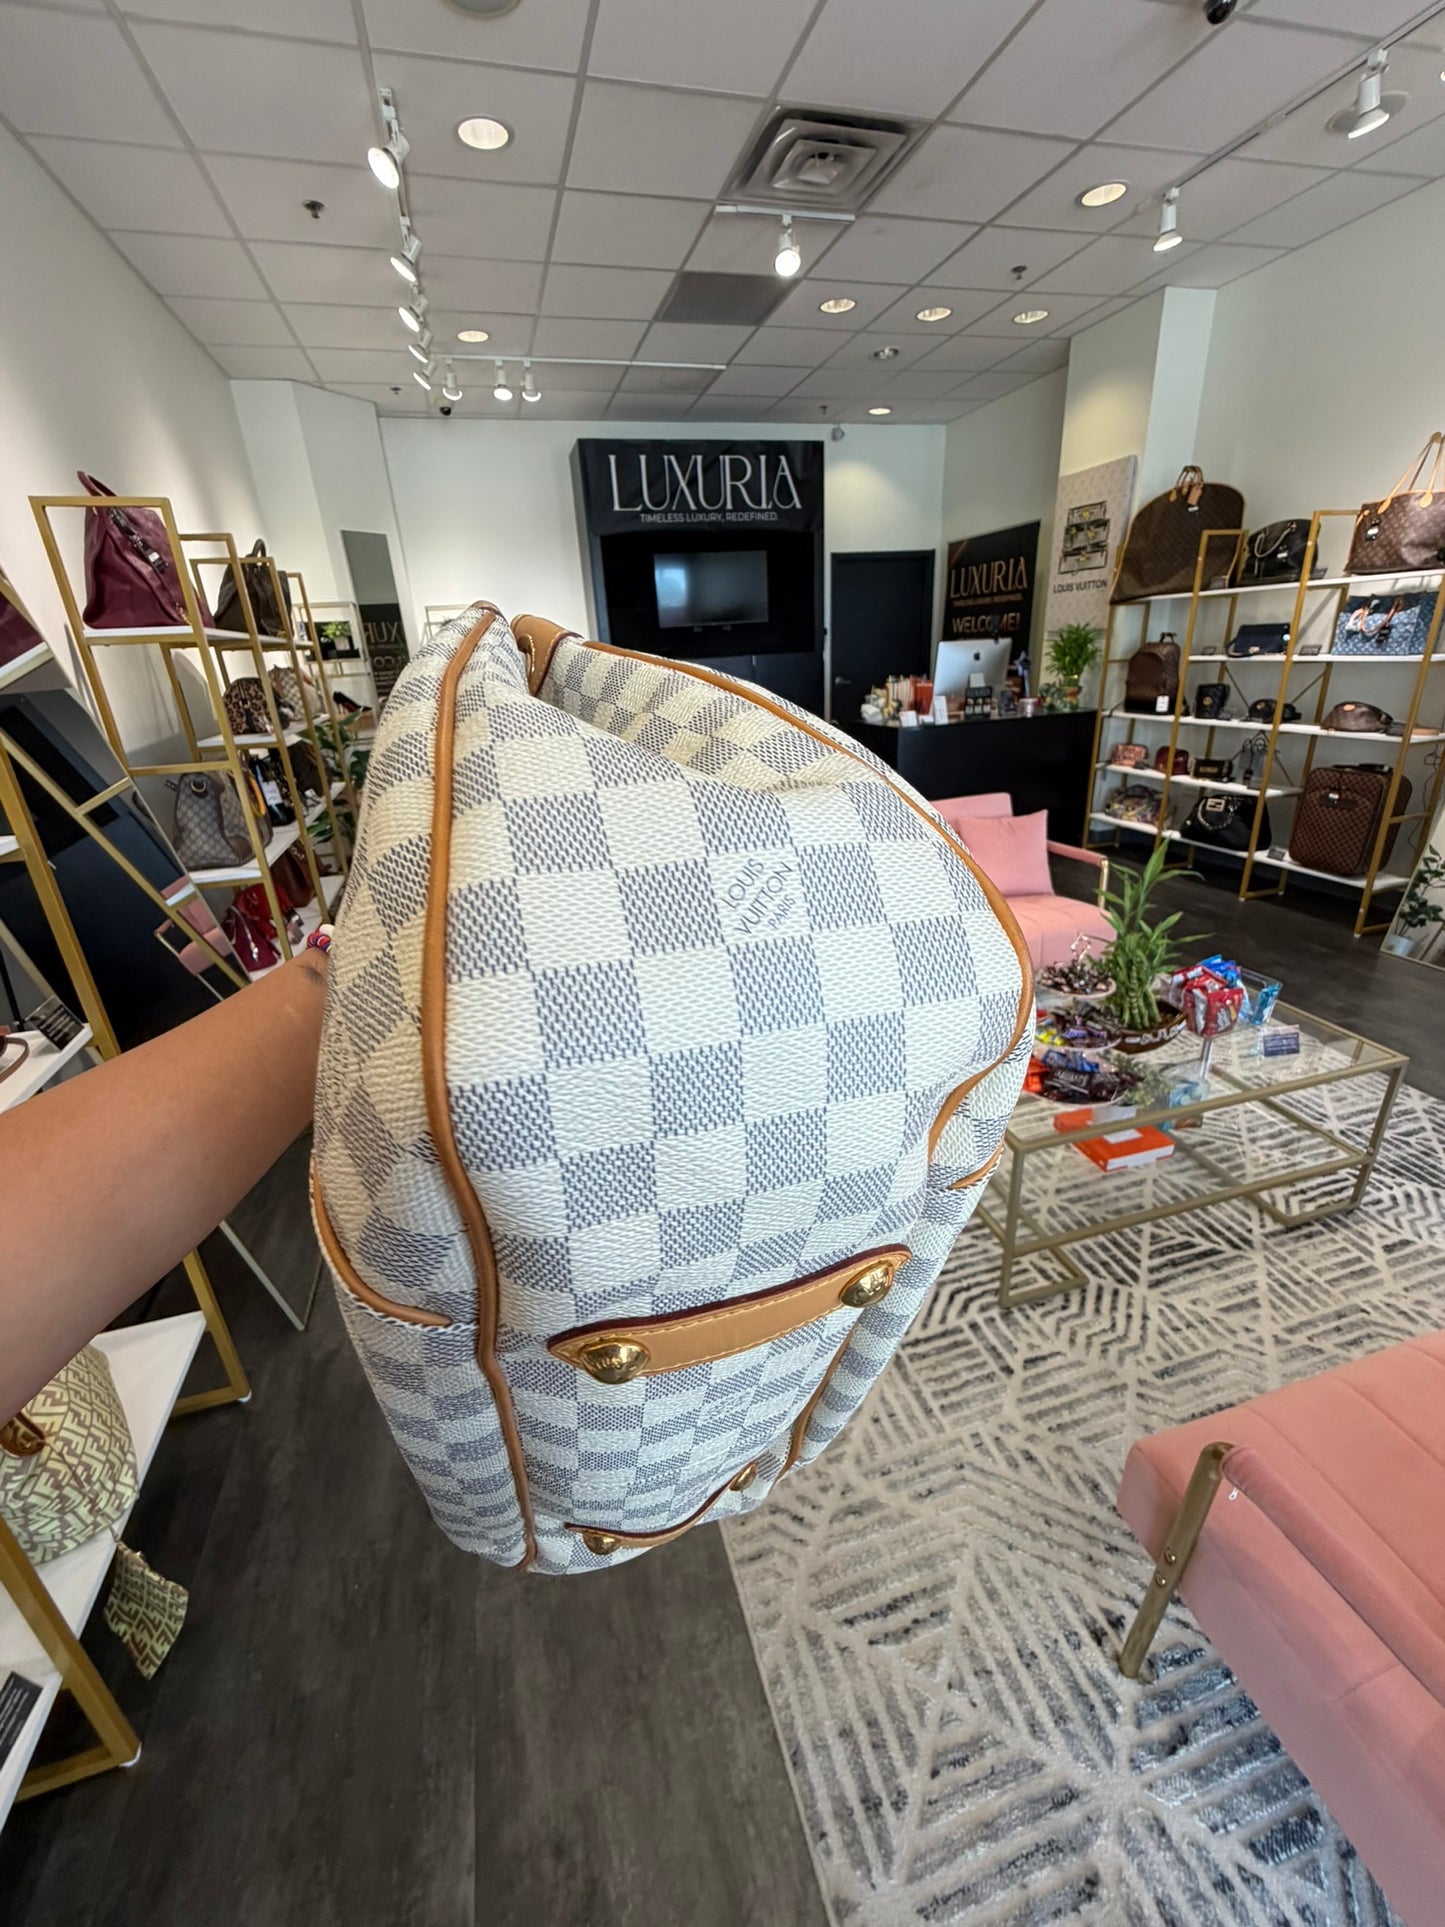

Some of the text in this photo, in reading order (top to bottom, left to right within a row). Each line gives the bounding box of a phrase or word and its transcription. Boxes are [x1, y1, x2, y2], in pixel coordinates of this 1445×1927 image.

[608, 454, 802, 511] LUXURIA
[640, 513, 685, 523] TIMELESS
[686, 512, 725, 523] LUXURY,
[950, 556, 1028, 598] LUXURIA
[1053, 579, 1108, 593] LOUIS VUITTON
[720, 858, 764, 909] LOUIS
[734, 861, 794, 934] VUITTON
[768, 894, 796, 930] PARIS
